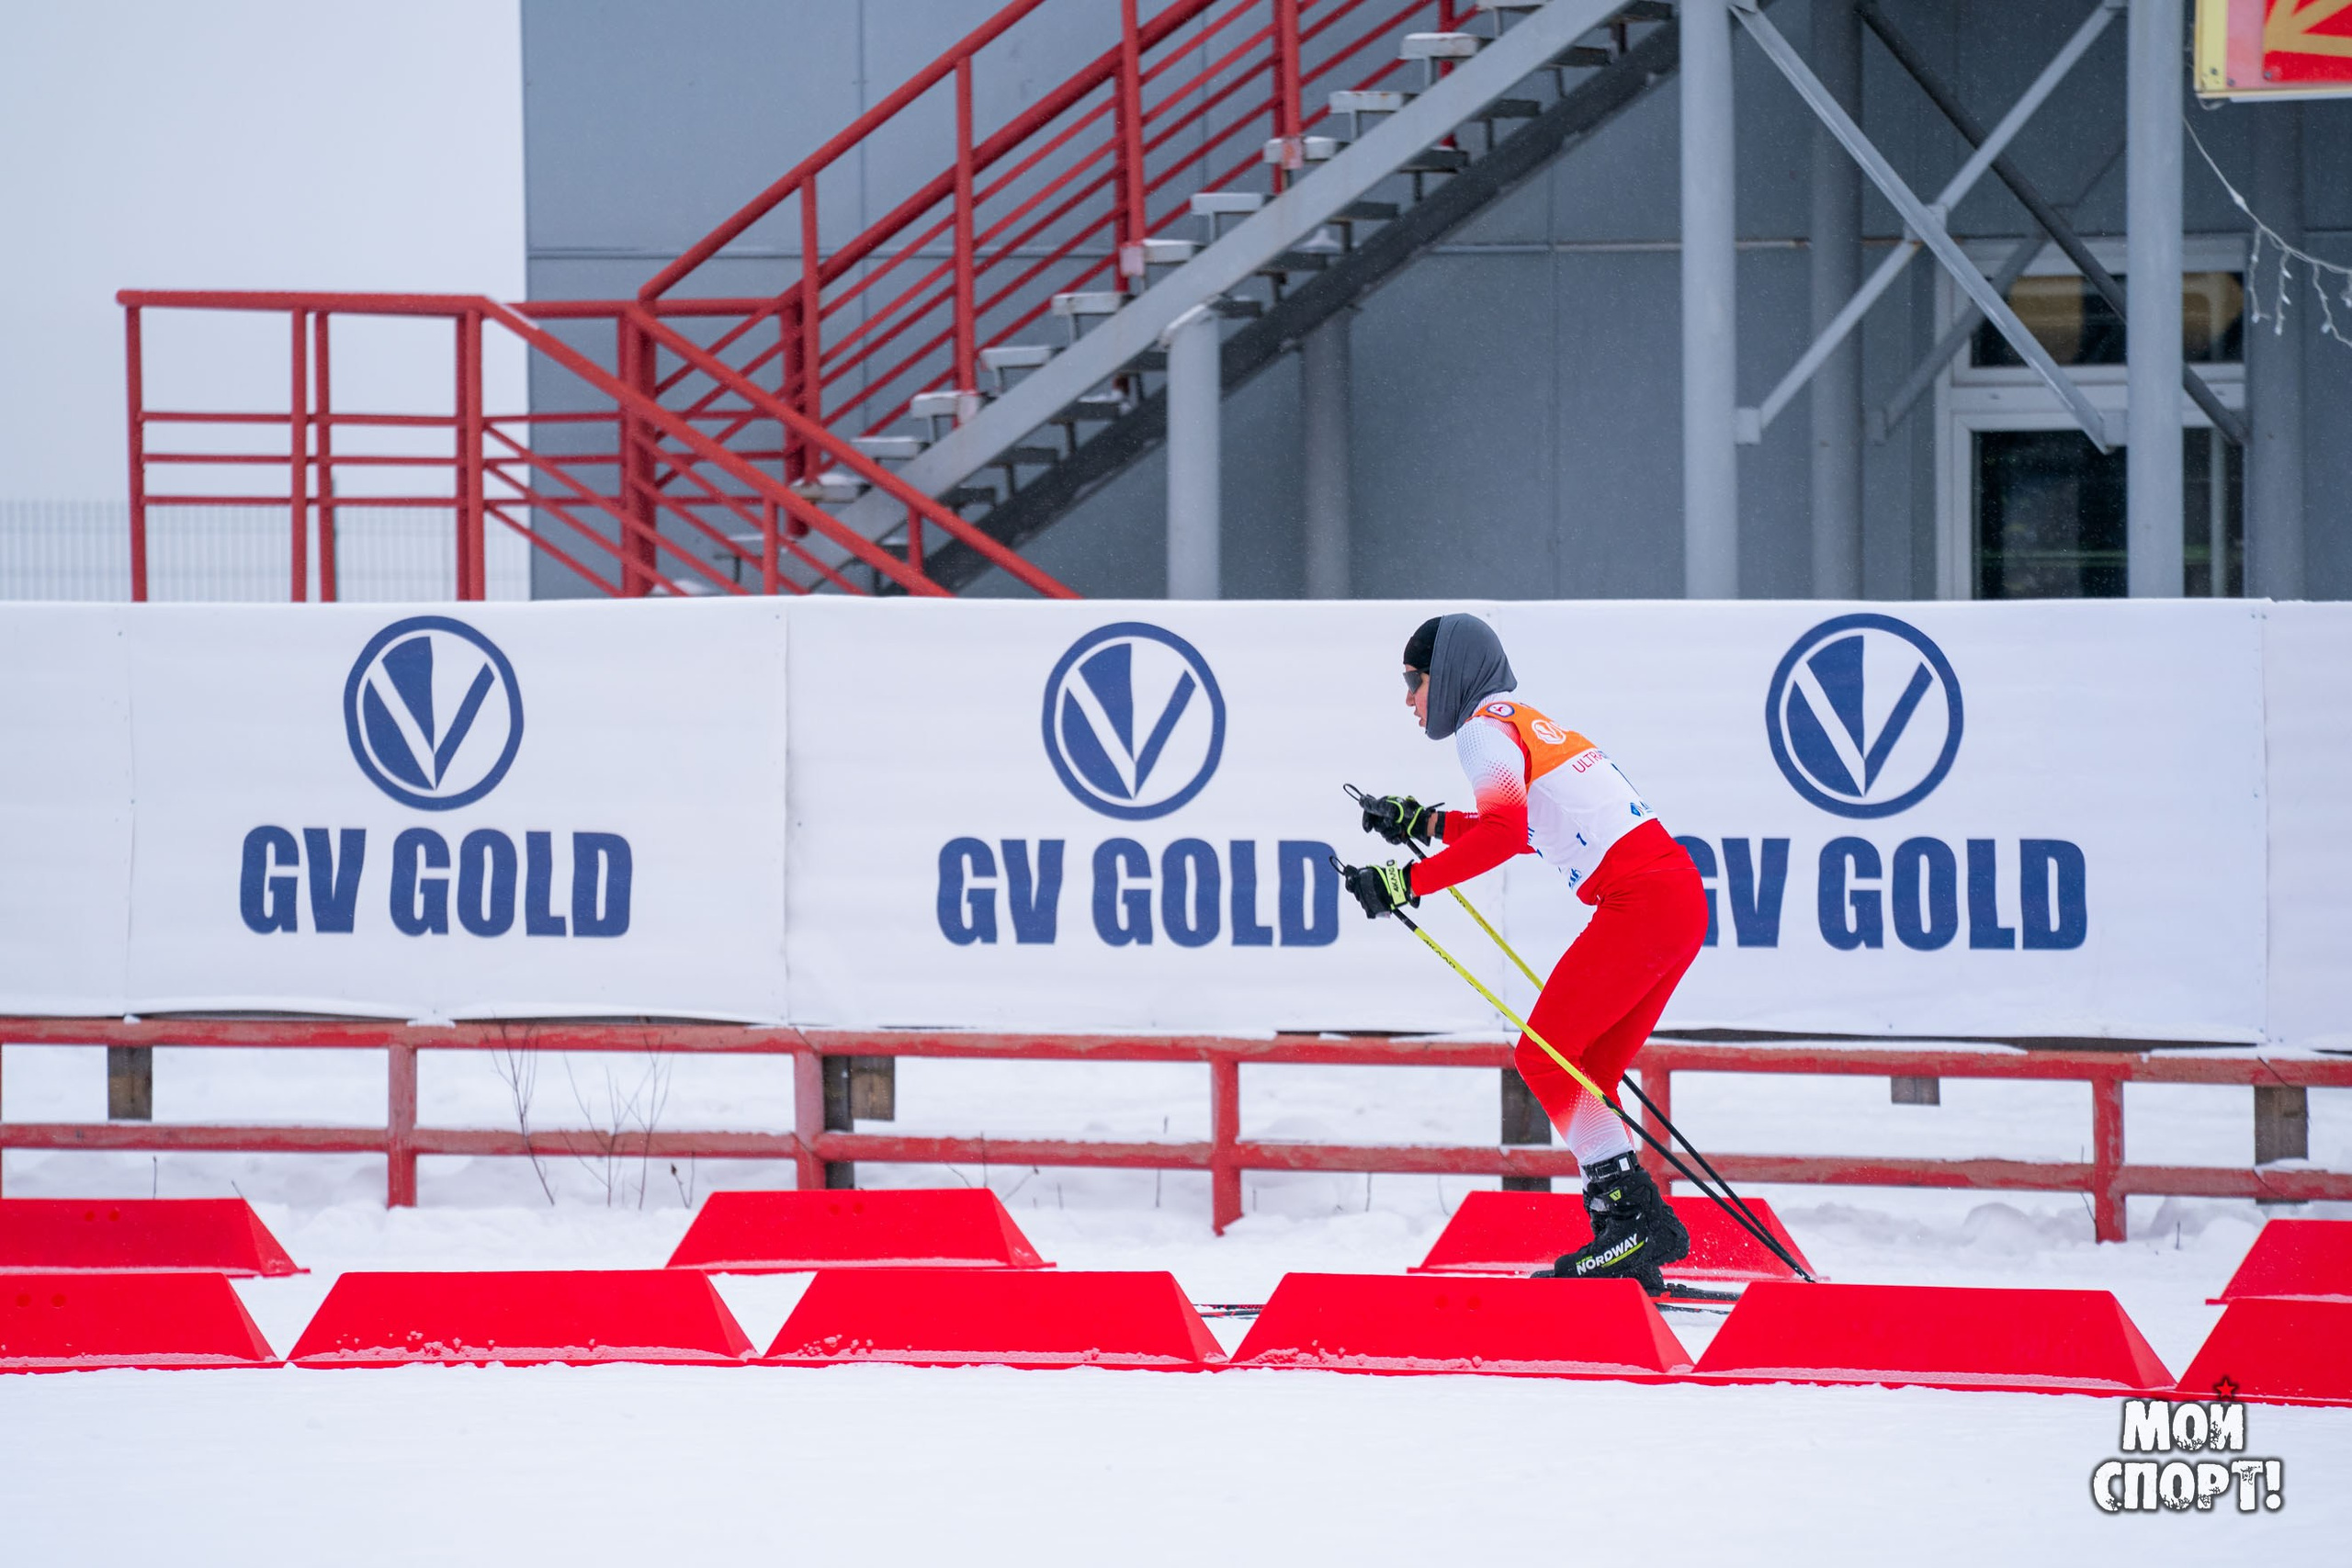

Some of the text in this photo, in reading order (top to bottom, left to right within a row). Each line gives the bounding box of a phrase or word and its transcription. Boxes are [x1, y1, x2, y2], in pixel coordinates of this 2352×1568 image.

[240, 826, 632, 937] GV GOLD
[937, 838, 1341, 947] GV GOLD
[1818, 837, 2087, 951] GOLD
[1576, 1233, 1638, 1276] NORDWAY
